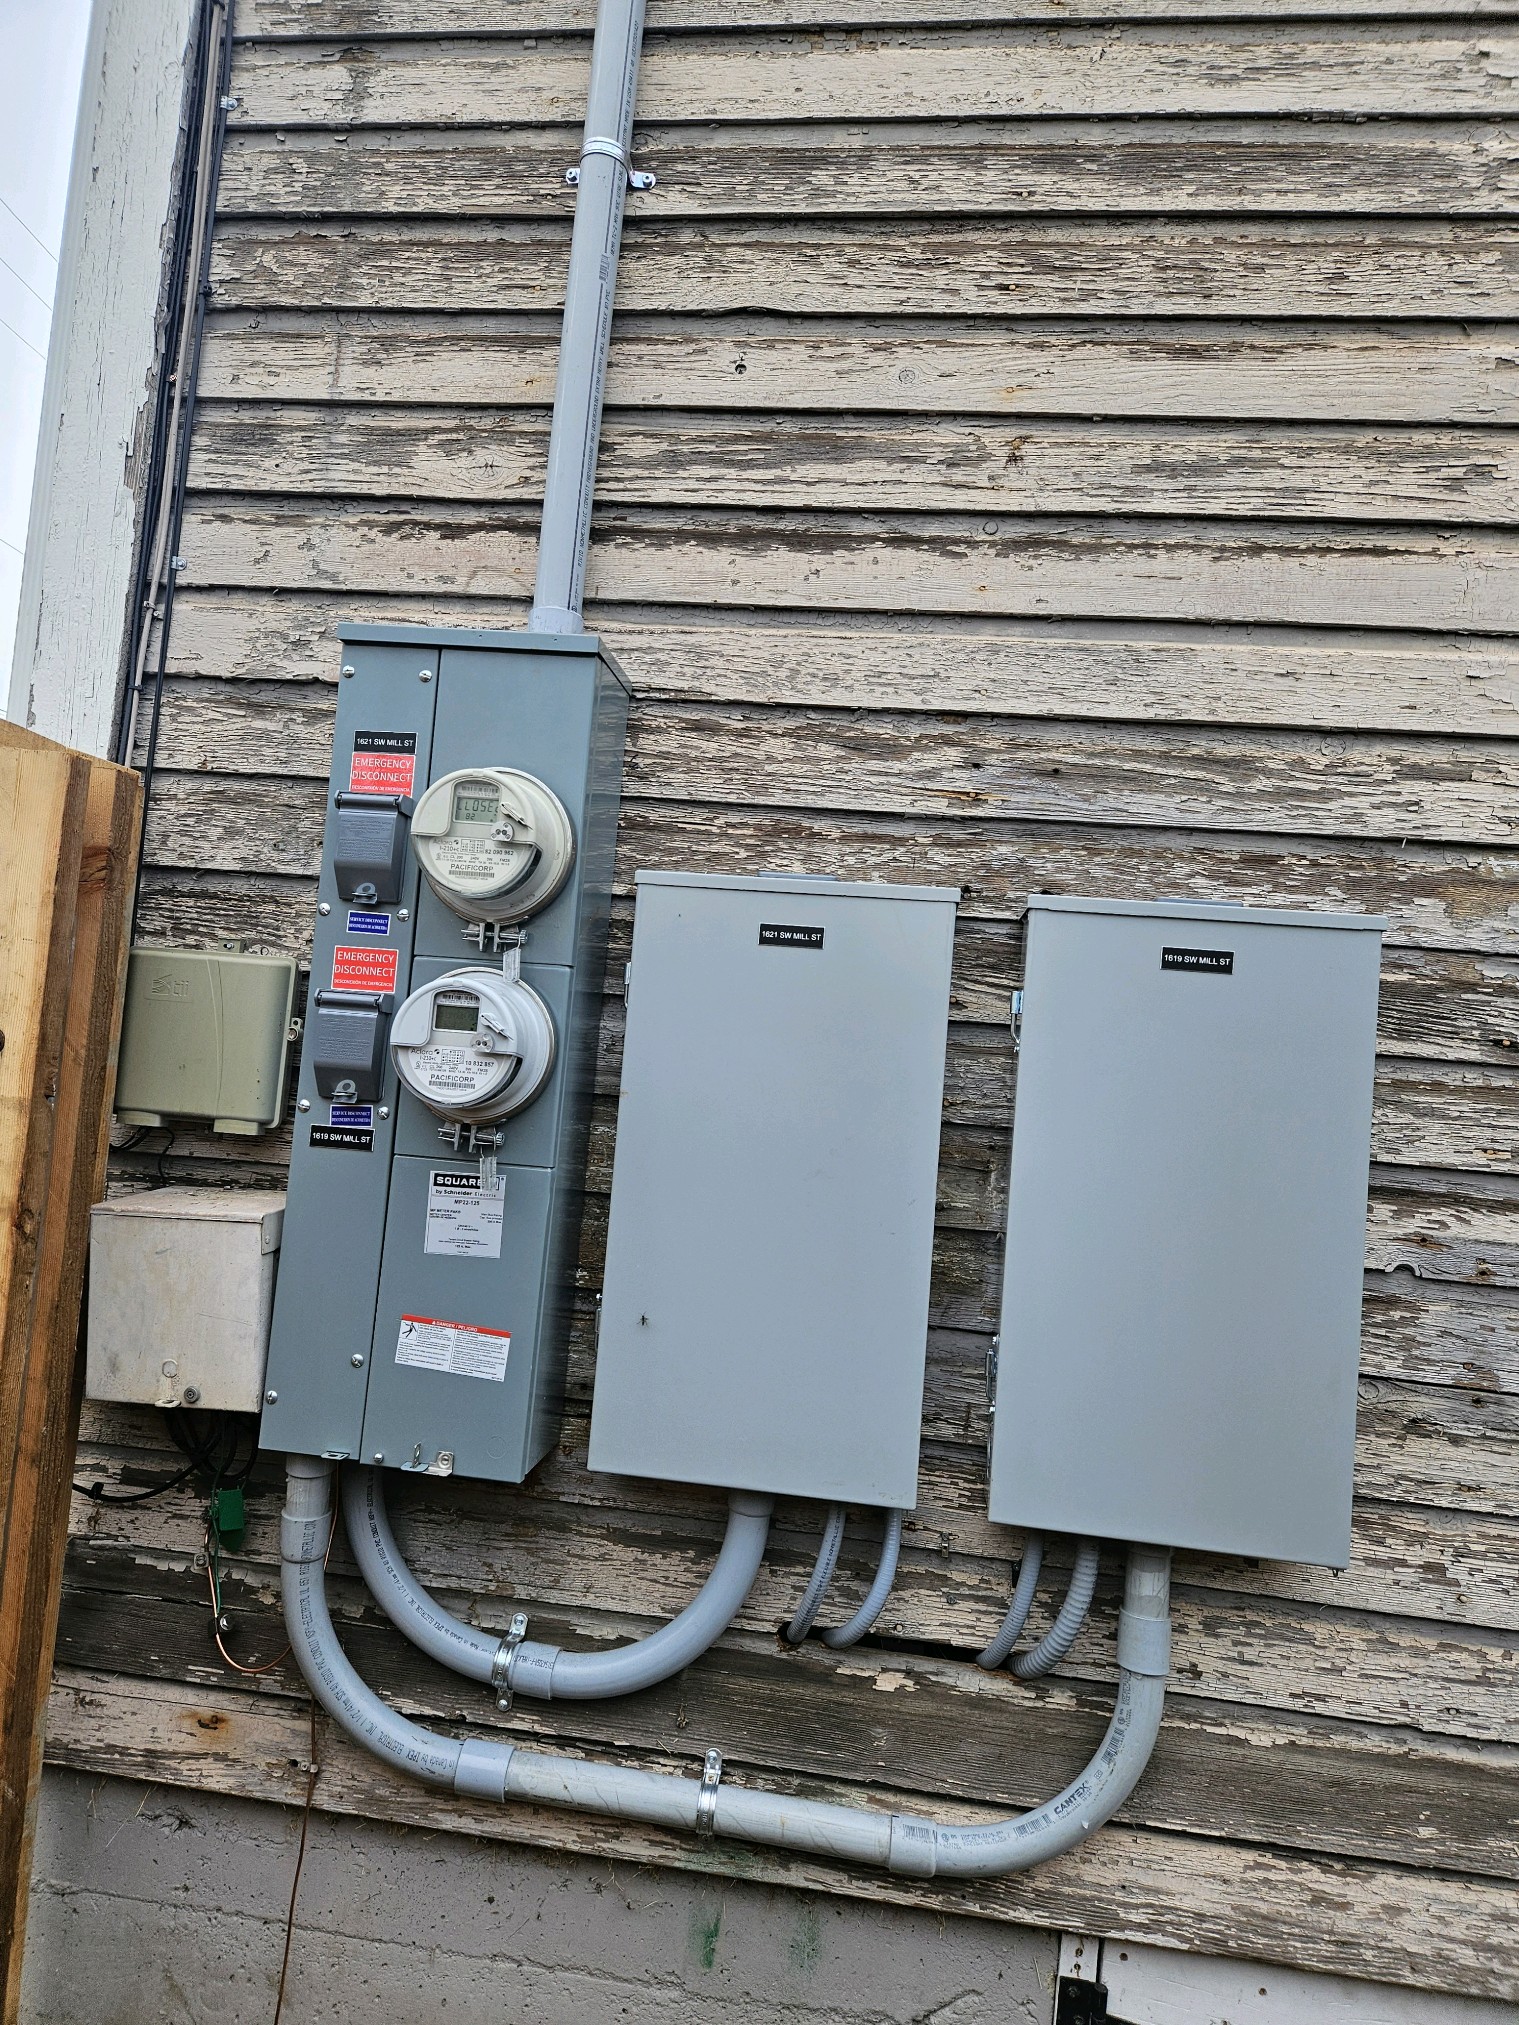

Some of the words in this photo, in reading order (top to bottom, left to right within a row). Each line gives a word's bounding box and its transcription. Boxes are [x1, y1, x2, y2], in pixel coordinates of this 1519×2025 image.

[355, 758, 411, 769] EMERGENCY
[352, 771, 412, 782] DISCONNECT
[450, 863, 494, 872] PACIFICORP
[762, 930, 778, 938] 1621
[780, 931, 792, 939] SW
[793, 932, 810, 940] MILL
[811, 933, 821, 941] ST
[337, 951, 395, 963] EMERGENCY
[1164, 954, 1183, 962] 1619
[1184, 955, 1198, 963] SW
[1199, 956, 1218, 965] MILL
[1219, 958, 1231, 966] ST
[334, 964, 395, 977] DISCONNECT
[430, 1074, 475, 1082] PACIFICORP
[312, 1132, 329, 1140] 1619
[329, 1133, 342, 1141] SW
[342, 1135, 360, 1143] MILL
[360, 1136, 371, 1144] ST
